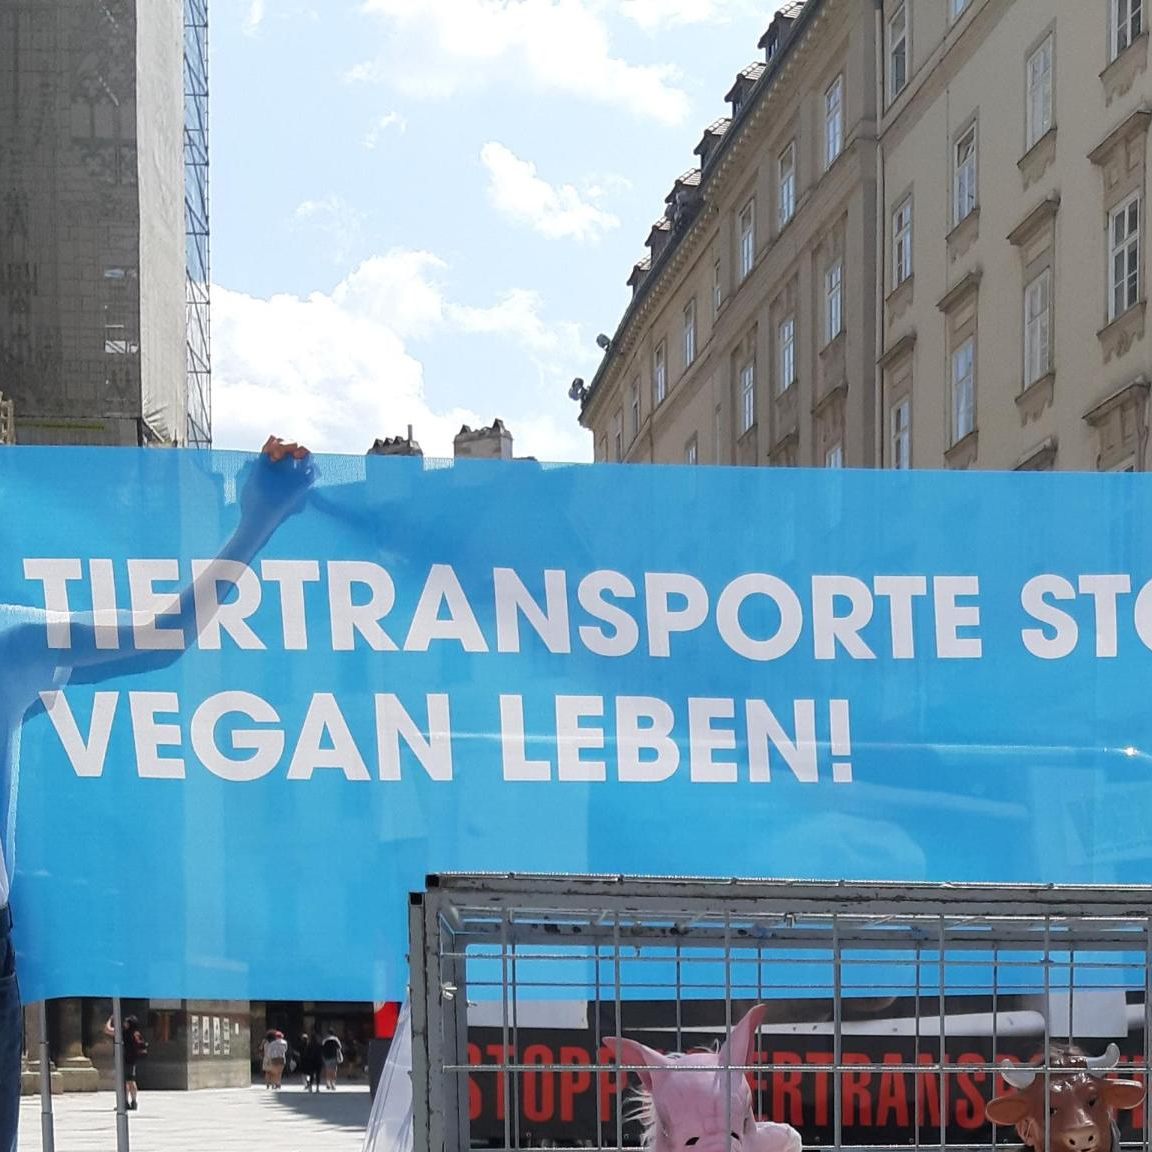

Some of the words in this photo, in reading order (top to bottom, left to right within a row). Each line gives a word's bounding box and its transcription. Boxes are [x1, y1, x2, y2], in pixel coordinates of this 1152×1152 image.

[23, 558, 982, 661] TIERTRANSPORTE
[39, 690, 453, 781] VEGAN
[502, 694, 852, 783] LEBEN!
